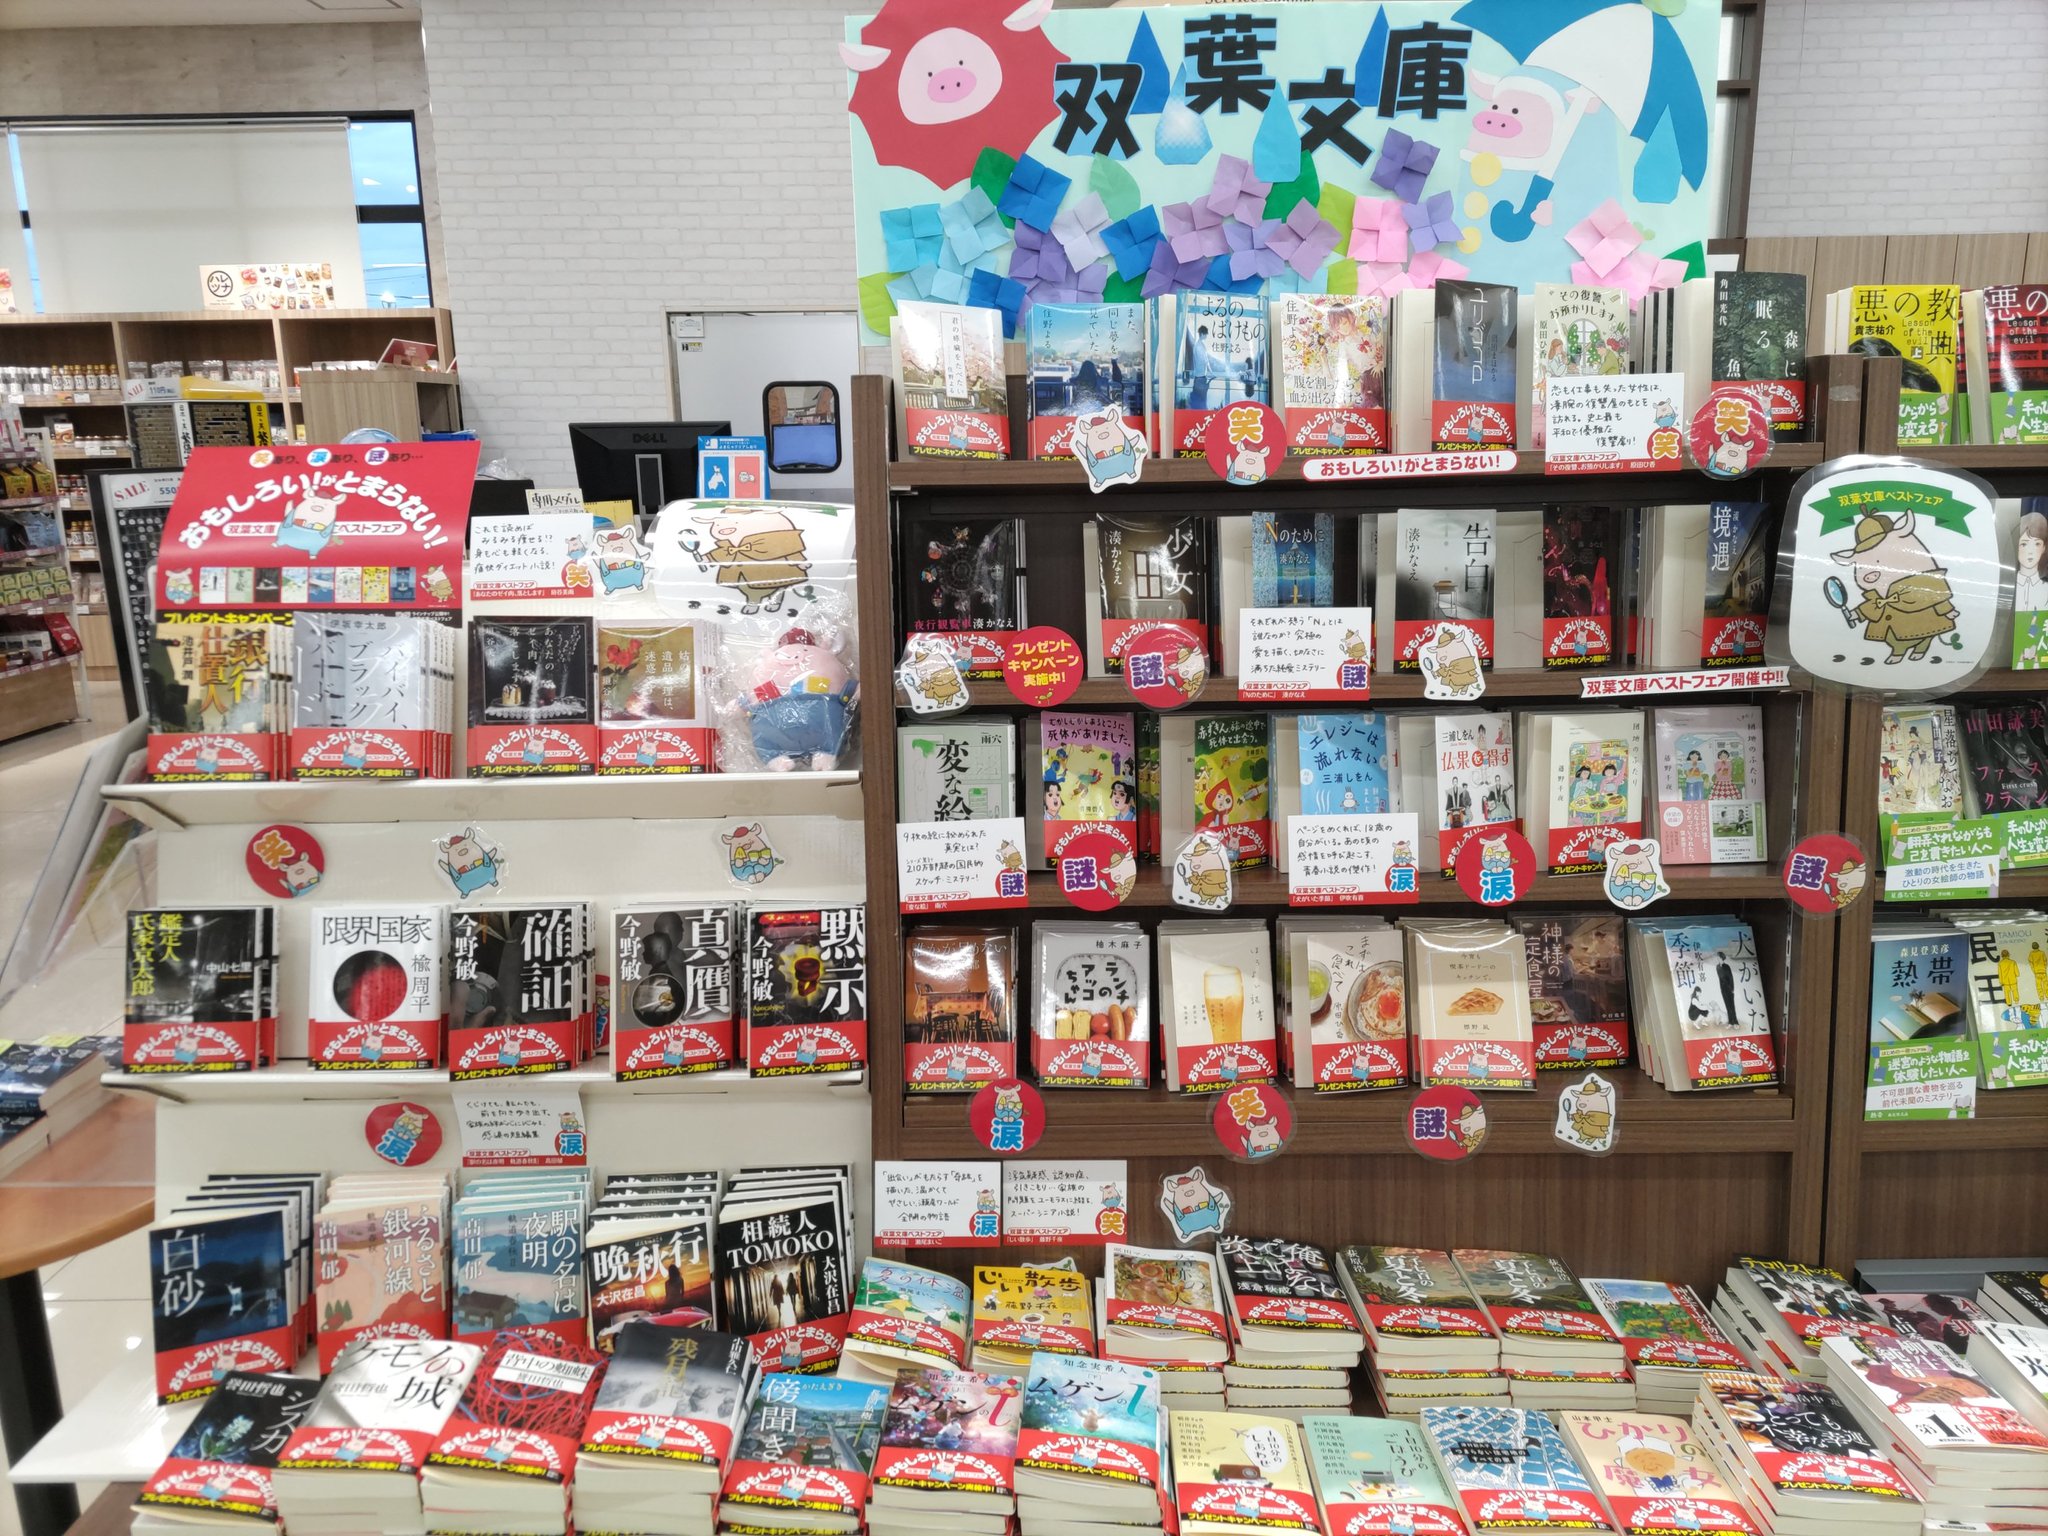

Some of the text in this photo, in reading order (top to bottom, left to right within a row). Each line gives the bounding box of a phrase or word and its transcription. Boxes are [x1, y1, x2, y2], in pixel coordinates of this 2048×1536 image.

[1054, 14, 1471, 165] 双葉文庫
[1202, 297, 1243, 317] よるの
[1550, 305, 1616, 321] お預かりします
[1720, 278, 1728, 326] 角田光代
[1108, 308, 1119, 354] 同じ夢を
[1211, 320, 1266, 341] ばけもの
[1287, 300, 1298, 351] 住野よる
[1756, 300, 1772, 349] 眠る
[1855, 325, 1895, 336] 貴志祐介
[1902, 319, 1935, 327] Lesson
[1903, 328, 1914, 336] of
[1211, 343, 1241, 353] 住野よる
[1539, 321, 1547, 358] 原田ひ香
[2014, 336, 2035, 344] evil
[1784, 331, 1797, 377] 森に
[1911, 347, 1923, 359] 上
[1727, 359, 1741, 378] 魚
[1229, 408, 1263, 443] 笑
[1715, 400, 1750, 435] 笑
[632, 431, 667, 444] DELL
[1552, 425, 1612, 437] 平和で優雅な
[1552, 453, 1617, 462] 双葉文庫ベストフェア
[1650, 432, 1681, 460] 笑
[1321, 455, 1501, 477] おもしろい!がとまらない!
[178, 471, 448, 550] おもしろい!がとまらない!
[1838, 490, 1943, 507] 双葉文庫ベストフェア
[226, 523, 402, 535] 双葉文庫 ベストフェア
[474, 523, 534, 534] これを読めば
[1265, 521, 1325, 545] Nのために
[1712, 506, 1731, 572] 境遇
[1109, 530, 1123, 585] 湊かなえ
[1166, 526, 1194, 596] 少女
[1280, 553, 1311, 565] 湊かなえ
[1408, 527, 1420, 582] 湊かなえ
[1463, 523, 1491, 593] 告白
[565, 564, 591, 587] 笑
[914, 618, 1014, 631] 夜行観覧車 湊かなえ
[1013, 640, 1071, 656] プレゼント
[228, 628, 269, 703] 銀行
[1007, 655, 1079, 671] キャンペーン
[1128, 652, 1165, 689] 謎
[349, 642, 374, 721] ブラック
[1023, 672, 1066, 687] 実施中!
[1246, 682, 1308, 690] 双葉文庫ベストフェア
[1341, 664, 1367, 690] 謎
[1587, 670, 1785, 695] 双葉文庫ベストフェア開催中!!
[1282, 691, 1306, 699] 湊かなえ
[1967, 709, 2045, 733] 山田詠美
[981, 733, 1002, 745] 雨穴
[1047, 728, 1131, 747] 死体がありました。
[1208, 735, 1257, 749] 死体と出会う。
[1309, 721, 1379, 750] エレジーは
[1442, 728, 1474, 743] 三浦しをん
[1314, 748, 1378, 771] 流れない
[935, 739, 974, 822] 変な絵
[1322, 772, 1373, 784] 三浦しをん
[2002, 782, 2018, 790] First
[254, 831, 294, 869] 笑
[1062, 857, 1098, 891] 謎
[1389, 868, 1416, 893] 涙
[1789, 854, 1826, 889] 謎
[1902, 871, 1985, 888] ひとりの女絵師の物語
[1905, 861, 1982, 877] 激動の時代を生きた
[1000, 871, 1026, 897] 謎
[1480, 868, 1515, 903] 涙
[159, 913, 182, 963] 鑑定人
[322, 916, 434, 945] 限界国家
[131, 914, 156, 997] 氏家京太郎
[454, 914, 479, 981] 今野敏
[619, 915, 642, 982] 今野敏
[1095, 940, 1143, 950] 柚木麻子
[1541, 922, 1564, 978] 神様の
[1900, 944, 1950, 958] 森見登美彦
[206, 961, 253, 973] 中山七里
[520, 909, 572, 1014] 確証
[683, 909, 730, 1018] 真贋
[752, 937, 774, 1002] 今野敏
[819, 909, 865, 1016] 黙示
[1332, 954, 1345, 992] 食べて
[1525, 935, 1543, 1001] 定食屋
[1667, 934, 1697, 989] 季節
[1892, 957, 1954, 989] 熱帯
[1970, 932, 2006, 1005] 民王
[410, 954, 431, 1014] 楡周平
[1731, 930, 1768, 1034] 犬がいた
[1888, 1051, 1970, 1071] 迷宮のような物語を
[1892, 1064, 1968, 1083] 体験したい人へ
[1880, 1081, 1963, 1098] 不可思議な書物を巡る
[1882, 1094, 1961, 1108] 前代未聞のミステリー
[1227, 1087, 1266, 1125] 笑
[991, 1118, 1025, 1151] 涙
[1414, 1108, 1447, 1139] 謎
[376, 1129, 416, 1165] 涙
[559, 1133, 584, 1155] 涙
[741, 1210, 816, 1244] 相続人
[975, 1215, 999, 1237] 涙
[1100, 1210, 1126, 1235] 笑
[382, 1209, 414, 1296] 銀河線
[522, 1212, 548, 1268] 夜明
[727, 1230, 834, 1269] TOMOKO
[412, 1206, 438, 1304] ふるさと
[550, 1209, 578, 1314] 駅の名は
[593, 1227, 704, 1286] 晩秋行
[159, 1230, 206, 1318] 白砂
[822, 1255, 841, 1314] 大沢在昌
[978, 1270, 1081, 1295] じい散歩
[596, 1284, 646, 1307] 大沢在昌
[1005, 1301, 1058, 1310] 藤野千夜
[504, 1352, 591, 1379] 背中の蜘蛛
[1063, 1358, 1127, 1374] 知念実希人
[802, 1383, 843, 1392] かたえぎき
[759, 1378, 801, 1461] 傍聞き
[1766, 1411, 1841, 1430] とっても
[1759, 1425, 1871, 1448] 不幸な幸運
[1603, 1465, 1723, 1489] 魔女
